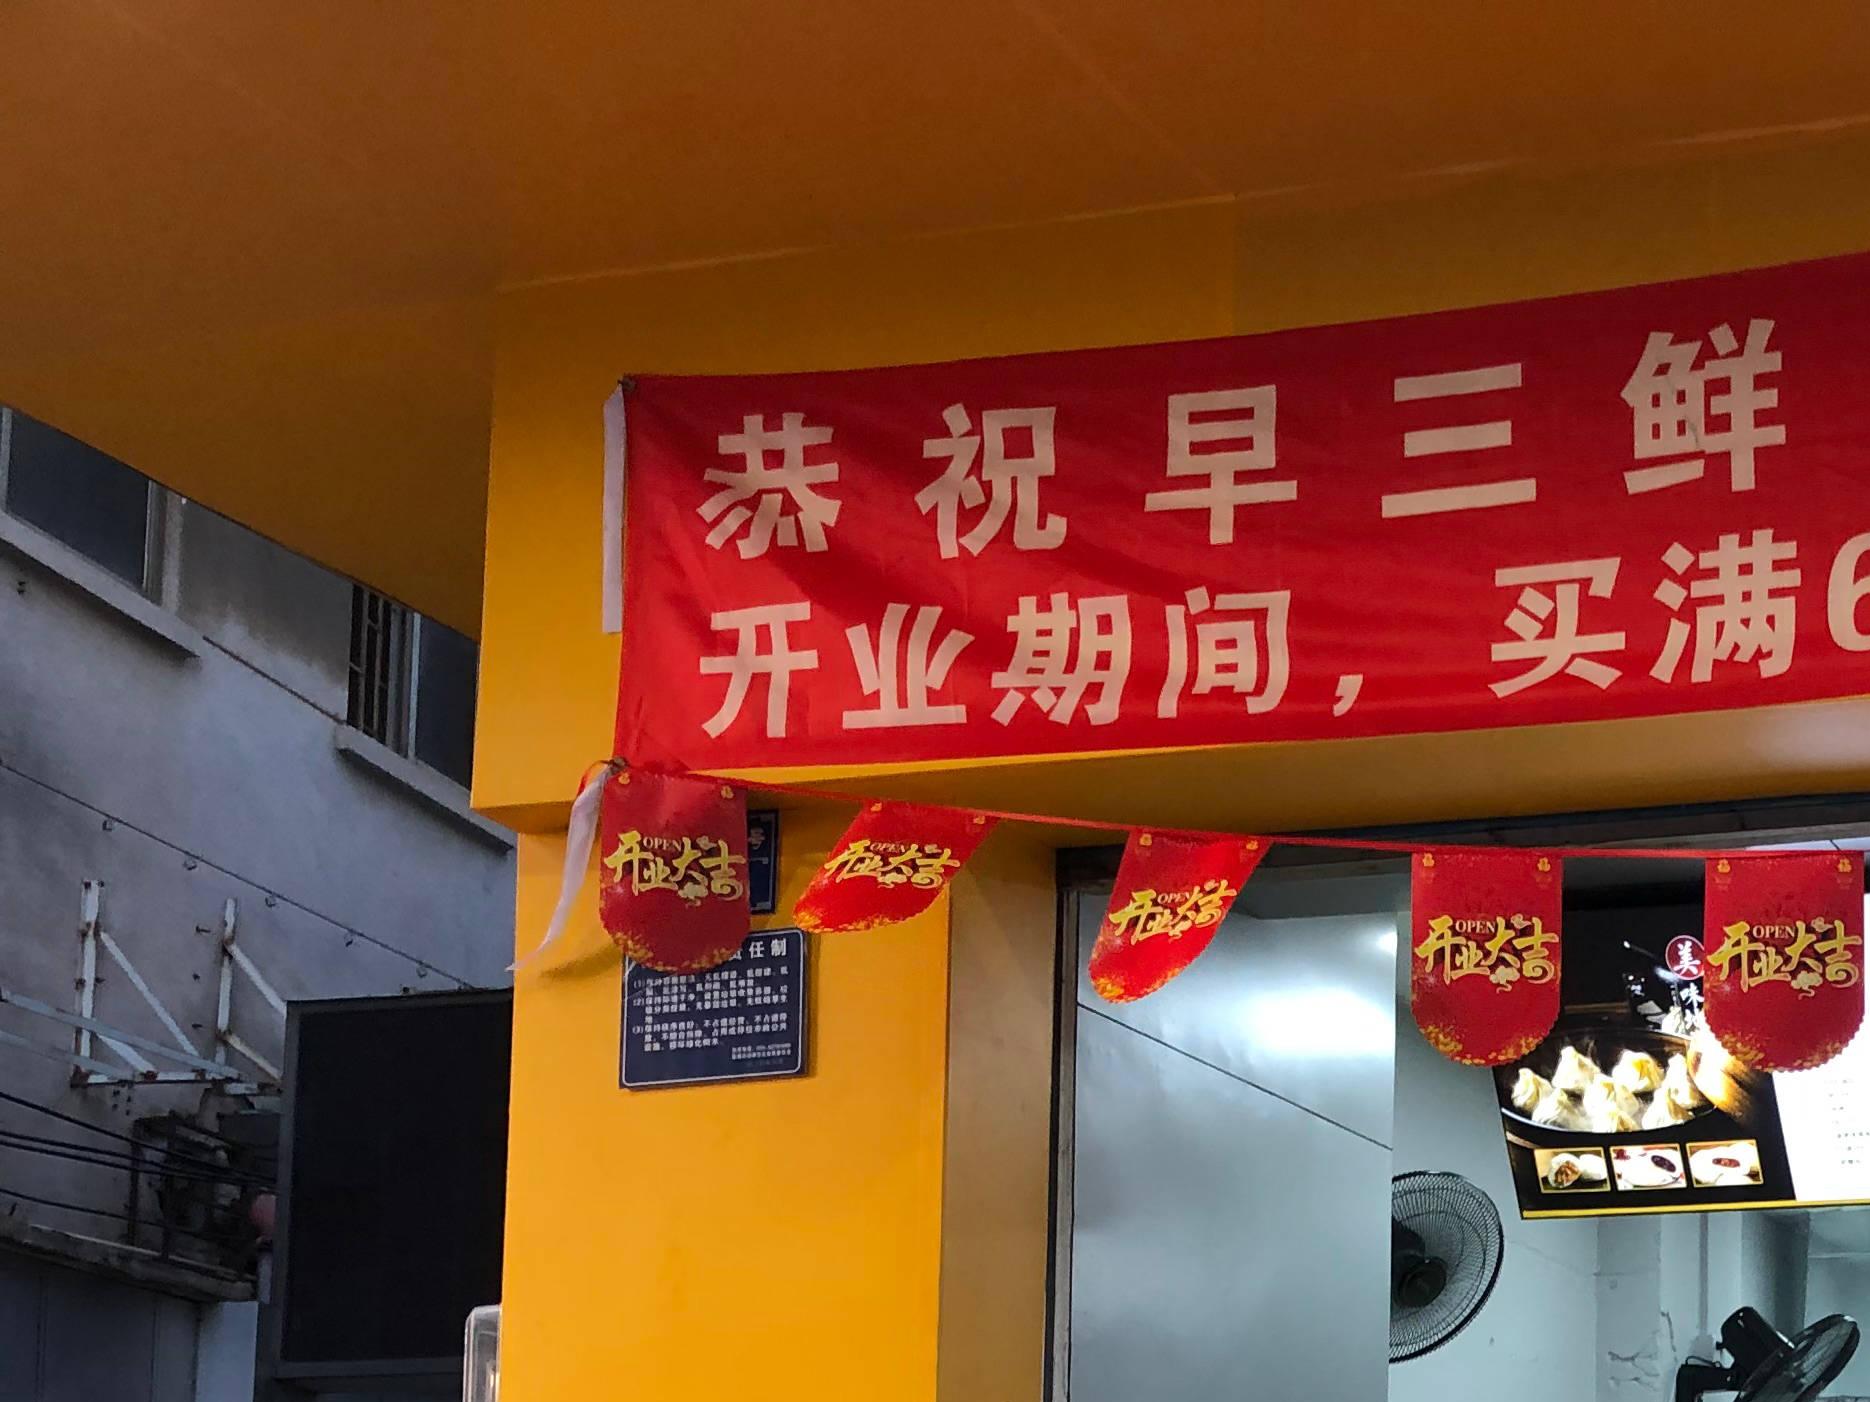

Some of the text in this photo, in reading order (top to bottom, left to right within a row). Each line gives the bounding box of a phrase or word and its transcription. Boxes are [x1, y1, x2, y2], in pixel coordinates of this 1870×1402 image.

[603, 831, 745, 900] 开业大吉
[643, 836, 682, 851] OPEN
[824, 840, 960, 888] 开业大吉
[1110, 880, 1236, 944] 开业大吉
[1157, 891, 1190, 905] OPEN
[1415, 916, 1558, 985] 开业大吉
[1456, 919, 1495, 934] OPEN
[1753, 924, 1795, 940] OPEN
[1707, 918, 1861, 993] 开业大吉
